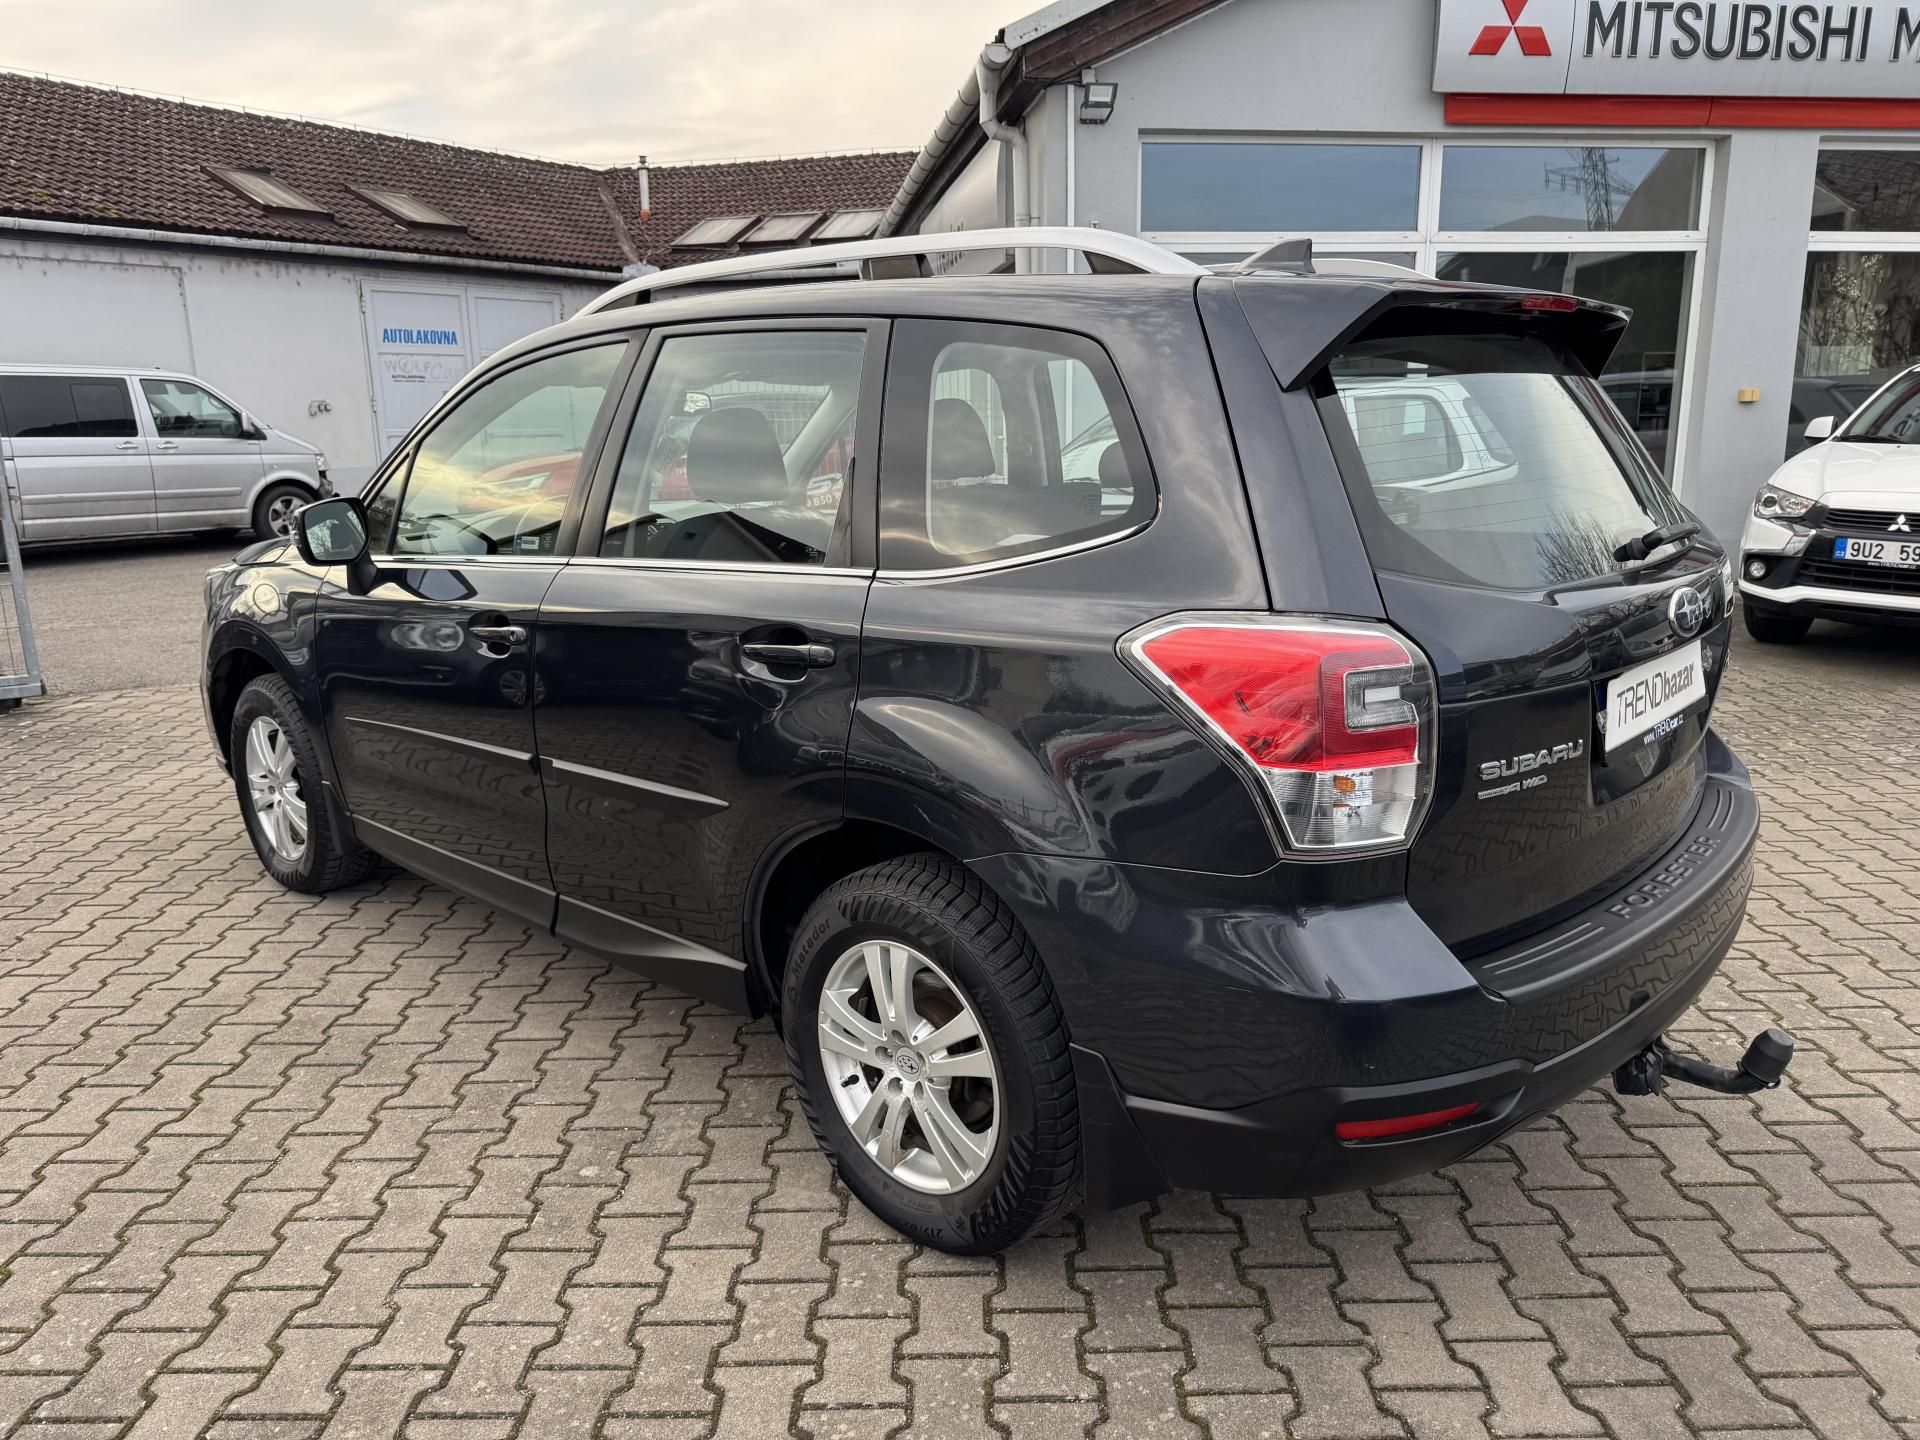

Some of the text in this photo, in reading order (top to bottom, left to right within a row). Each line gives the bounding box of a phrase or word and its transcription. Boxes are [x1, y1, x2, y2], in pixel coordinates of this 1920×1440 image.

[1583, 1, 1873, 61] MITSUBISHI
[382, 328, 458, 345] AUTOLAKOVNA
[1850, 541, 1884, 560] 9U2
[1616, 661, 1695, 728] TRENDbazar
[1479, 739, 1584, 780] SUBARU
[1603, 836, 1721, 919] FORESTER
[792, 917, 831, 979] Matador
